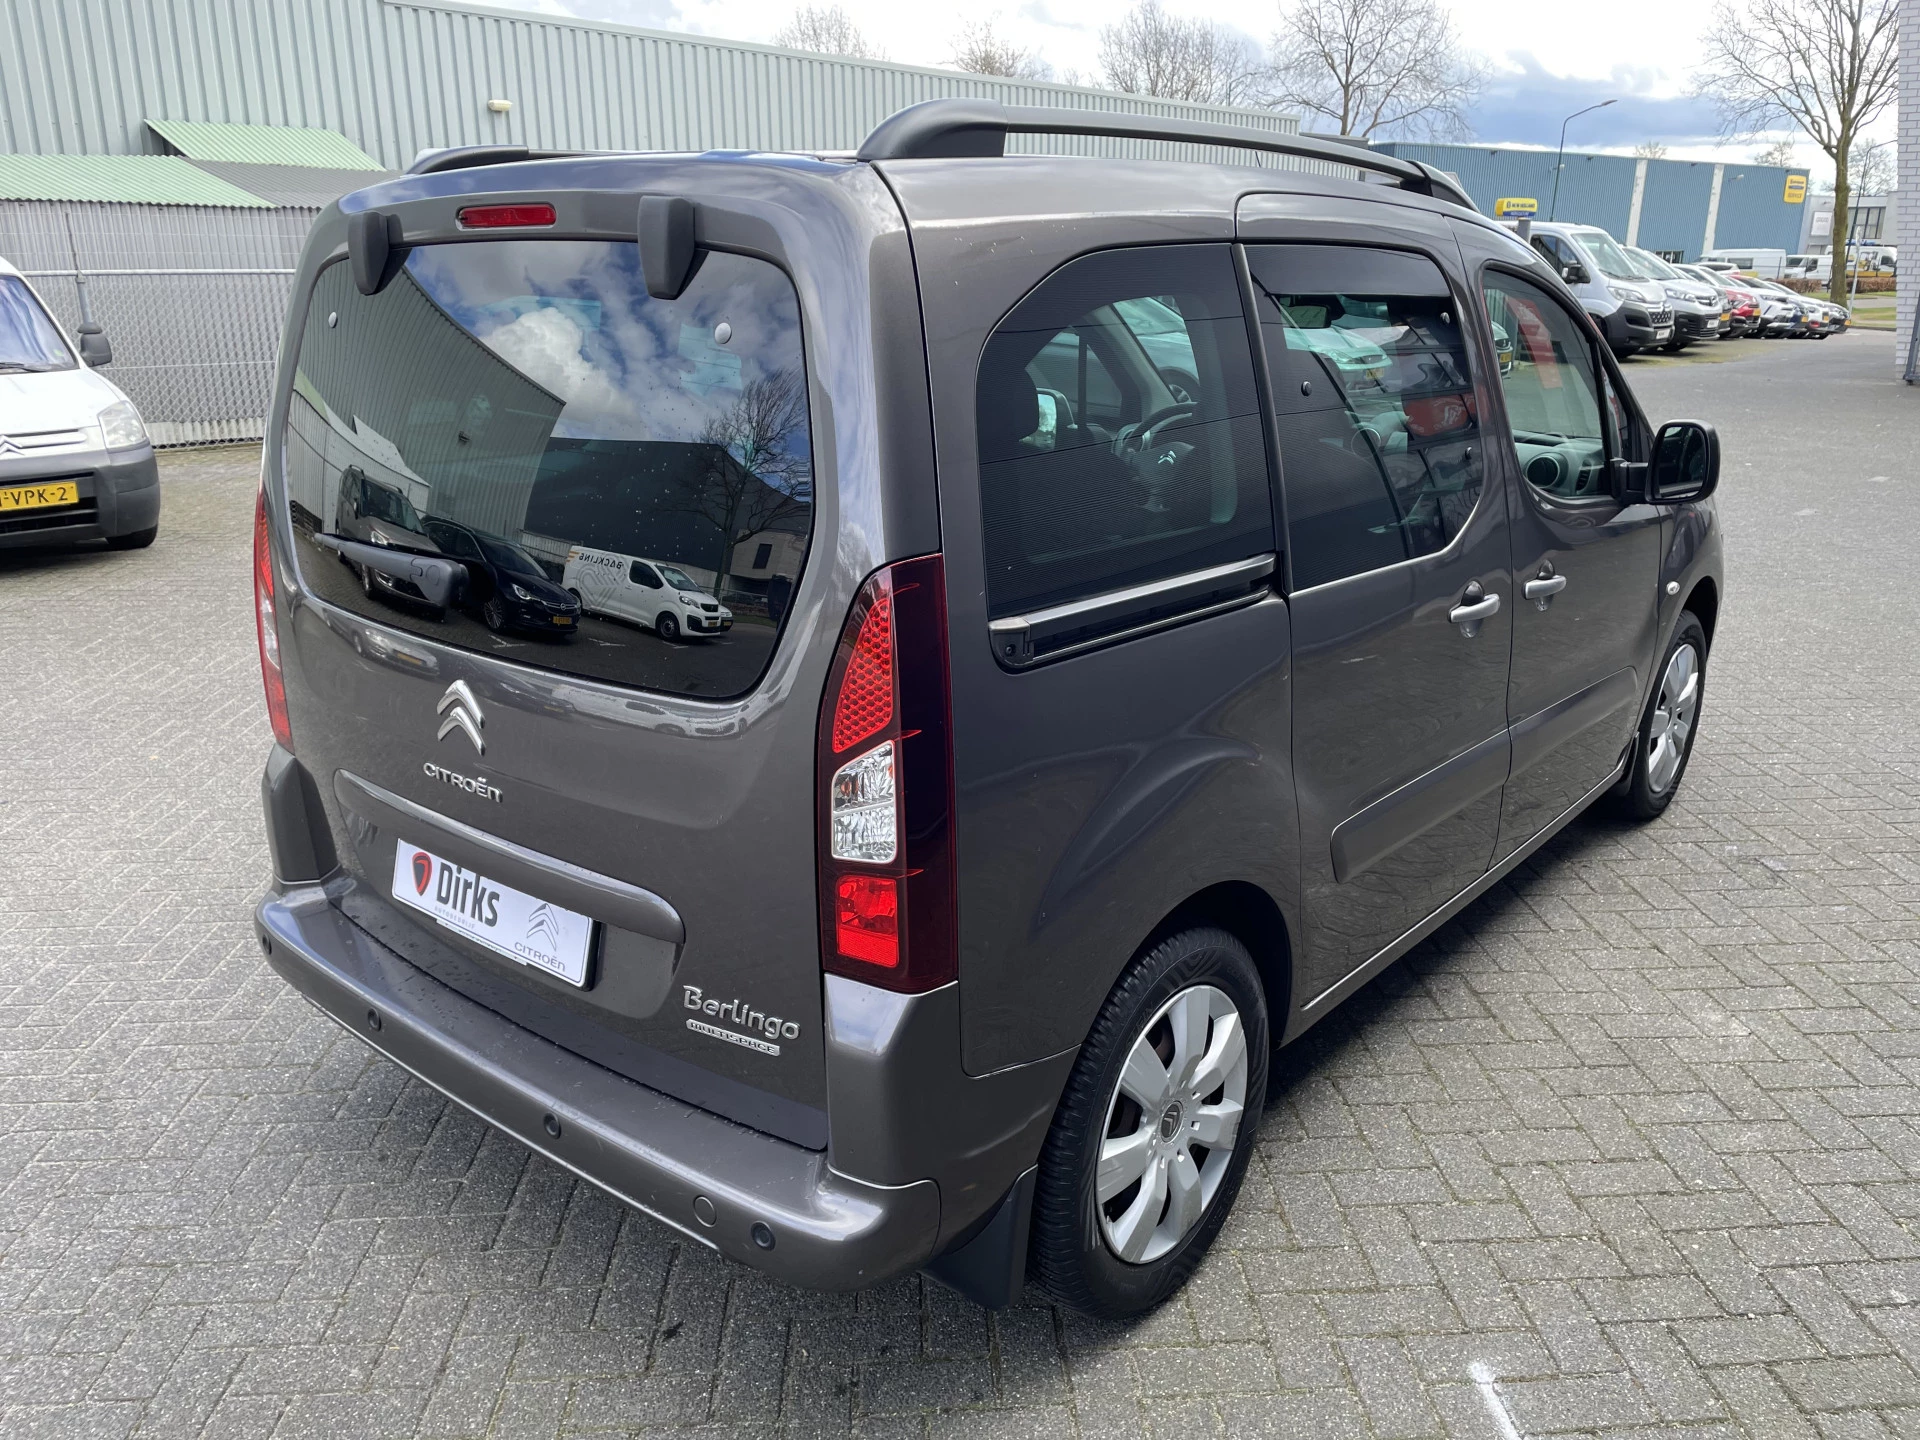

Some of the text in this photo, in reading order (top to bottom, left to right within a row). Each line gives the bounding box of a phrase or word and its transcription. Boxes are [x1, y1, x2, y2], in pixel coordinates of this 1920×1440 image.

[436, 862, 500, 927] Dirks
[683, 985, 801, 1040] Berlingo
[690, 1021, 777, 1055] MULTISPACE
